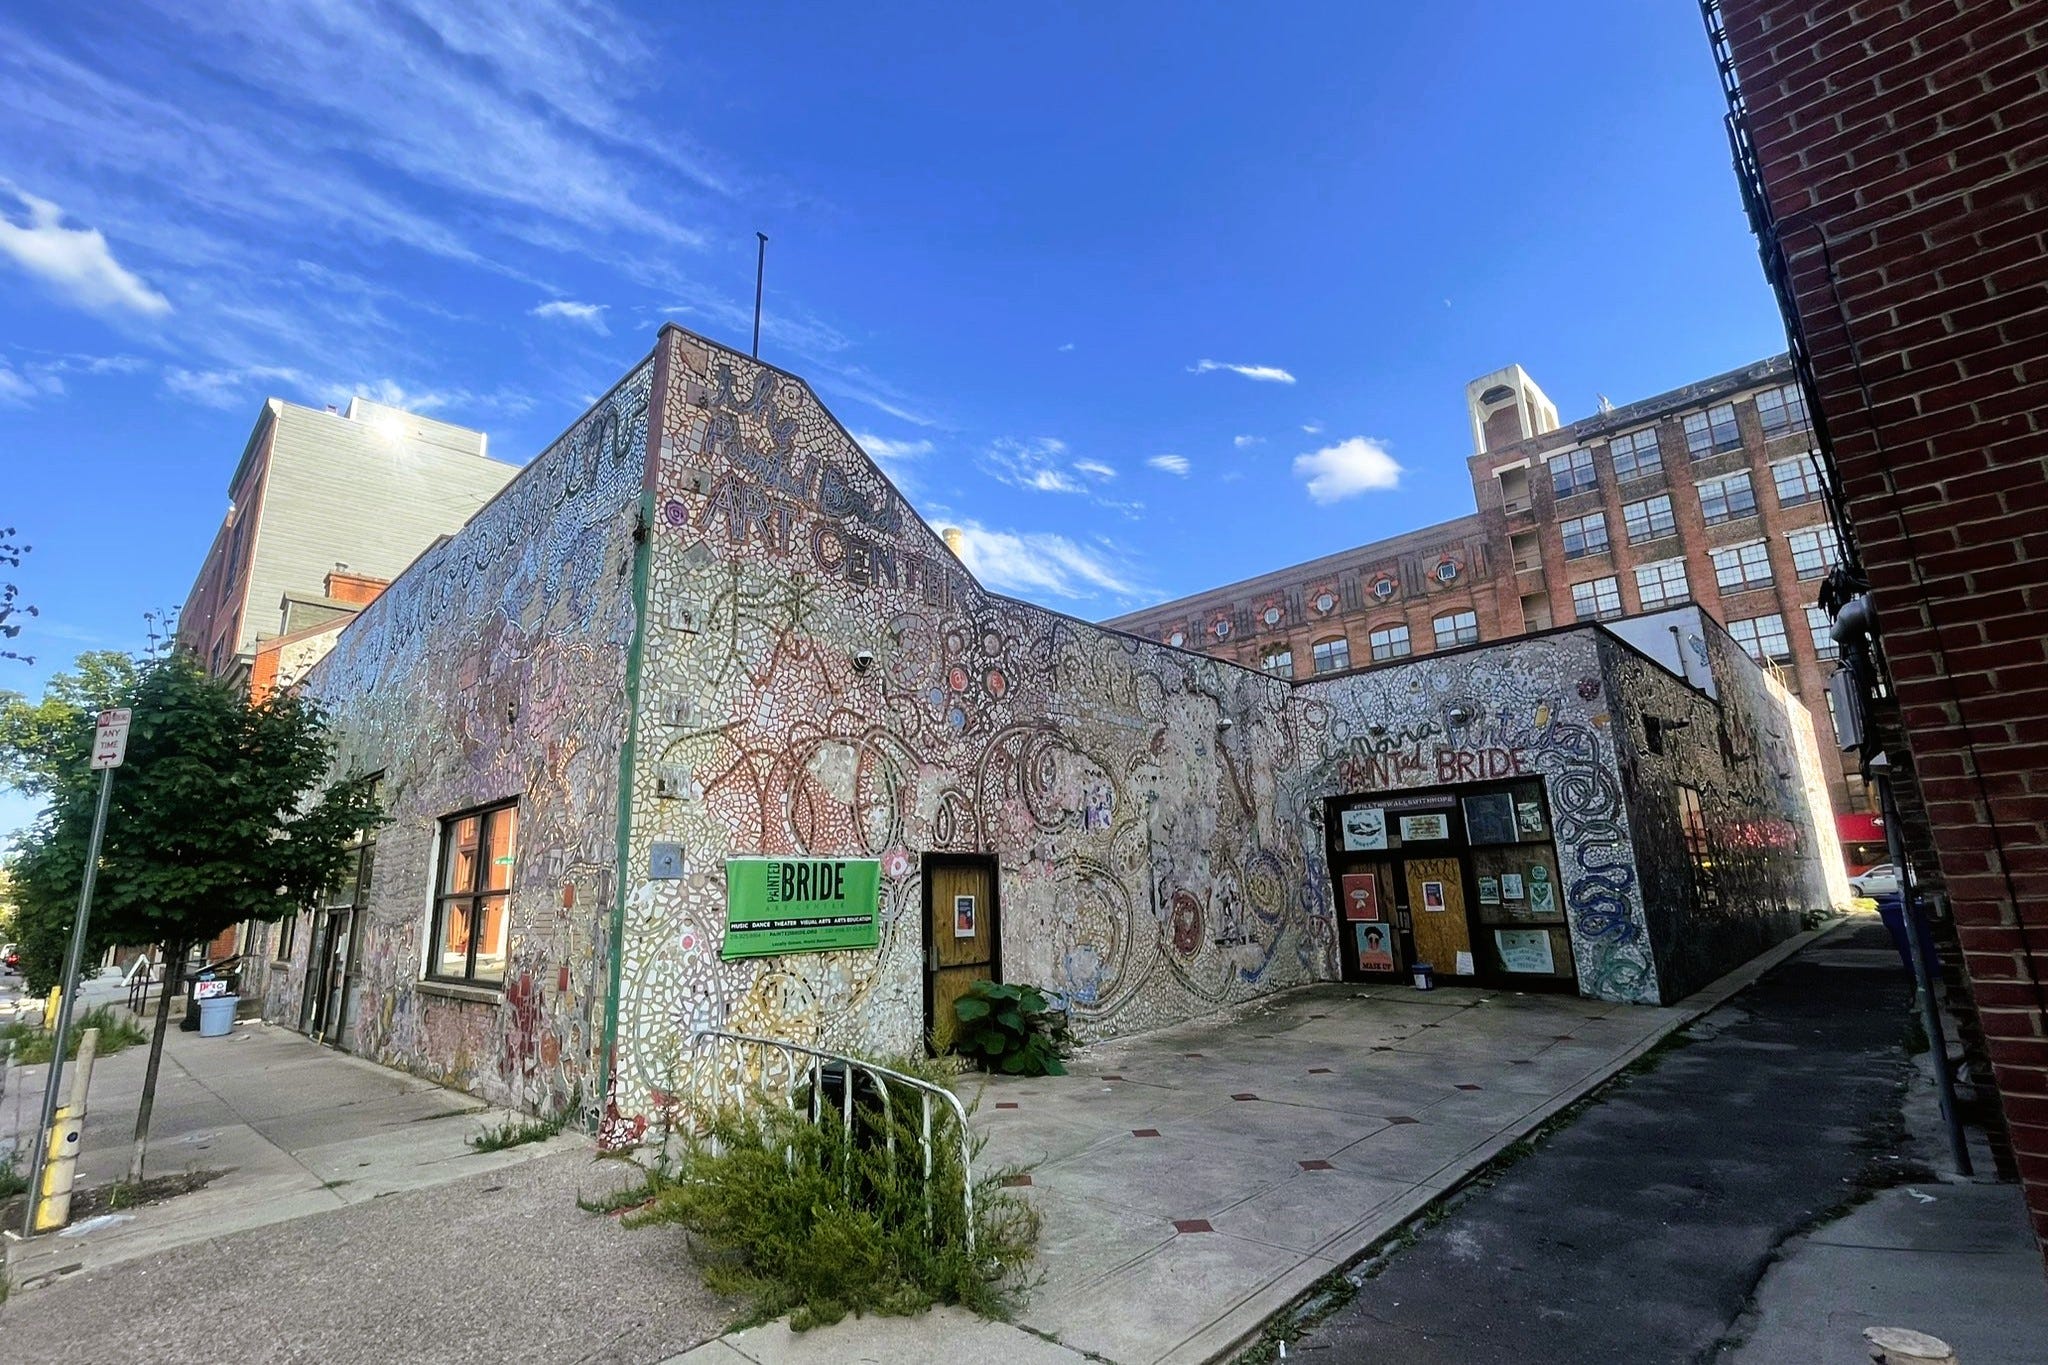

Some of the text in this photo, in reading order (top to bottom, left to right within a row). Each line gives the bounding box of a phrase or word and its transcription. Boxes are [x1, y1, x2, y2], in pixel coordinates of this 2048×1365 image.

[700, 473, 973, 611] ART CENTER
[101, 741, 118, 749] TIME
[1438, 748, 1526, 783] BRIDE
[767, 862, 781, 903] PAINTED
[781, 862, 846, 902] BRIDE
[1362, 962, 1381, 970] MASK
